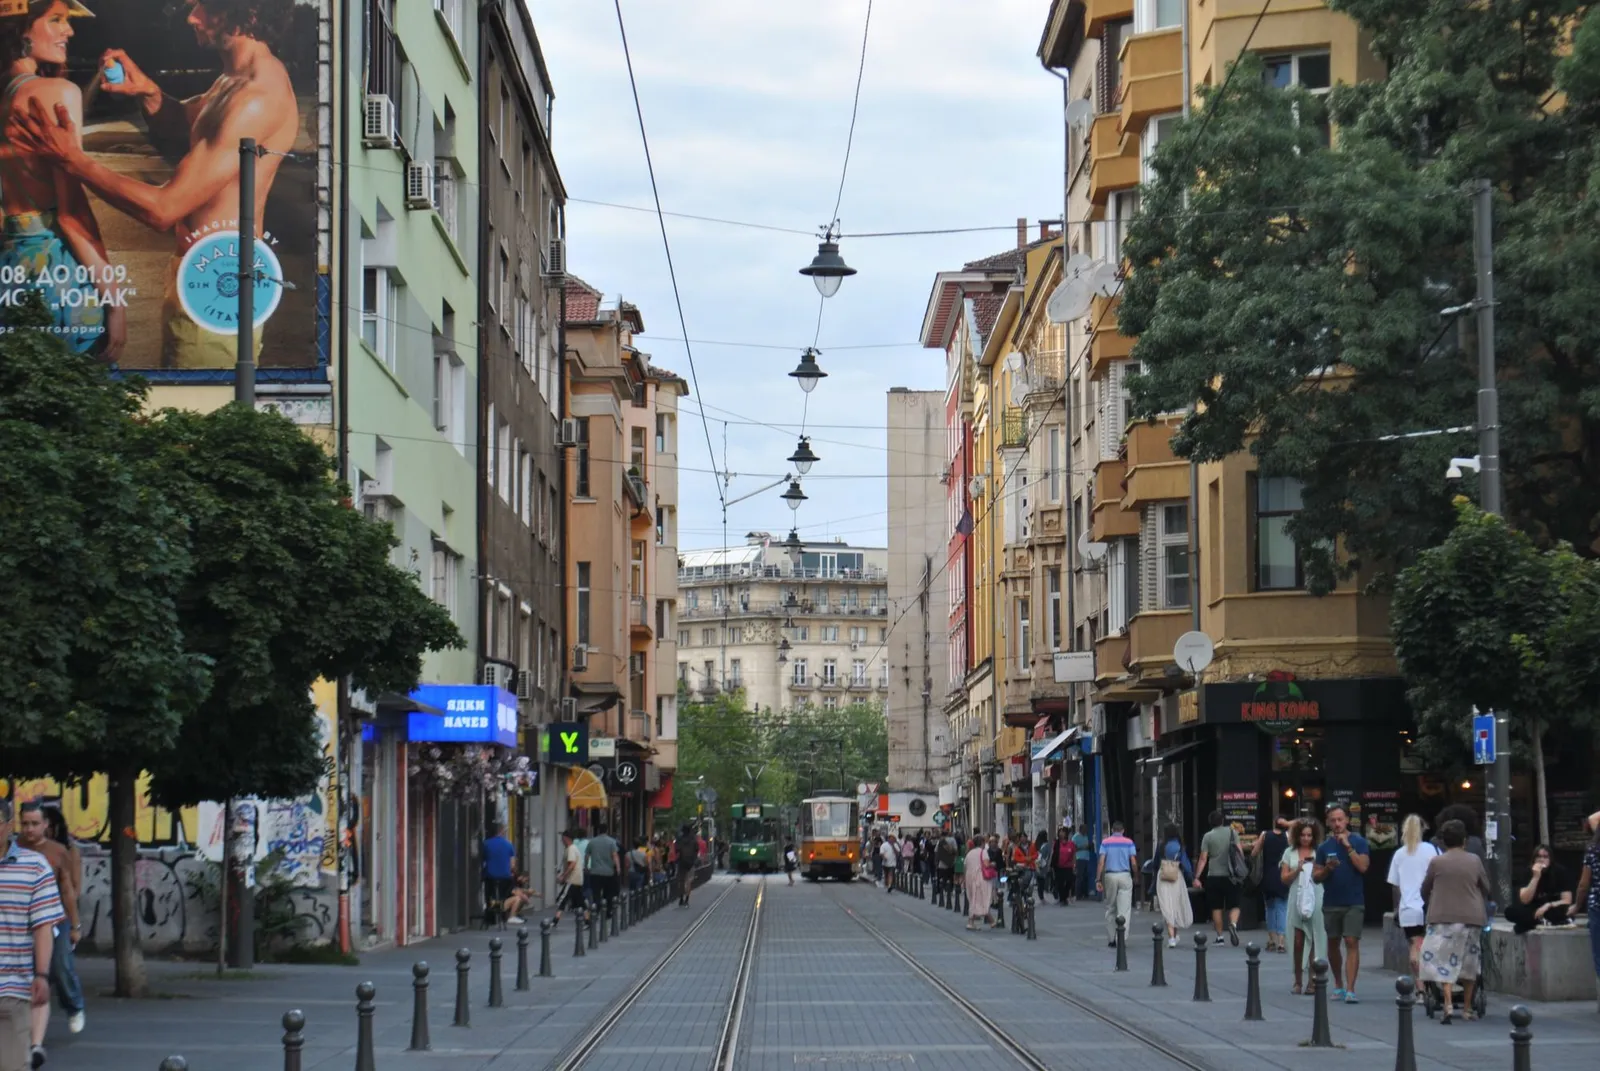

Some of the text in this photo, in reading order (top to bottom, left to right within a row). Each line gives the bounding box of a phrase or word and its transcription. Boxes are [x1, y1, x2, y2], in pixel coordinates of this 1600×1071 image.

[185, 220, 279, 245] IMAGIN BY
[194, 244, 265, 272] MALY
[35, 265, 70, 287] ДО
[75, 265, 132, 284] 01.09.
[188, 281, 210, 289] GIN
[51, 288, 137, 310] „ЮНАК“
[446, 699, 485, 712] ЯДКИ
[1241, 701, 1320, 721] KING KONG
[443, 716, 488, 729] НАЧЕВ
